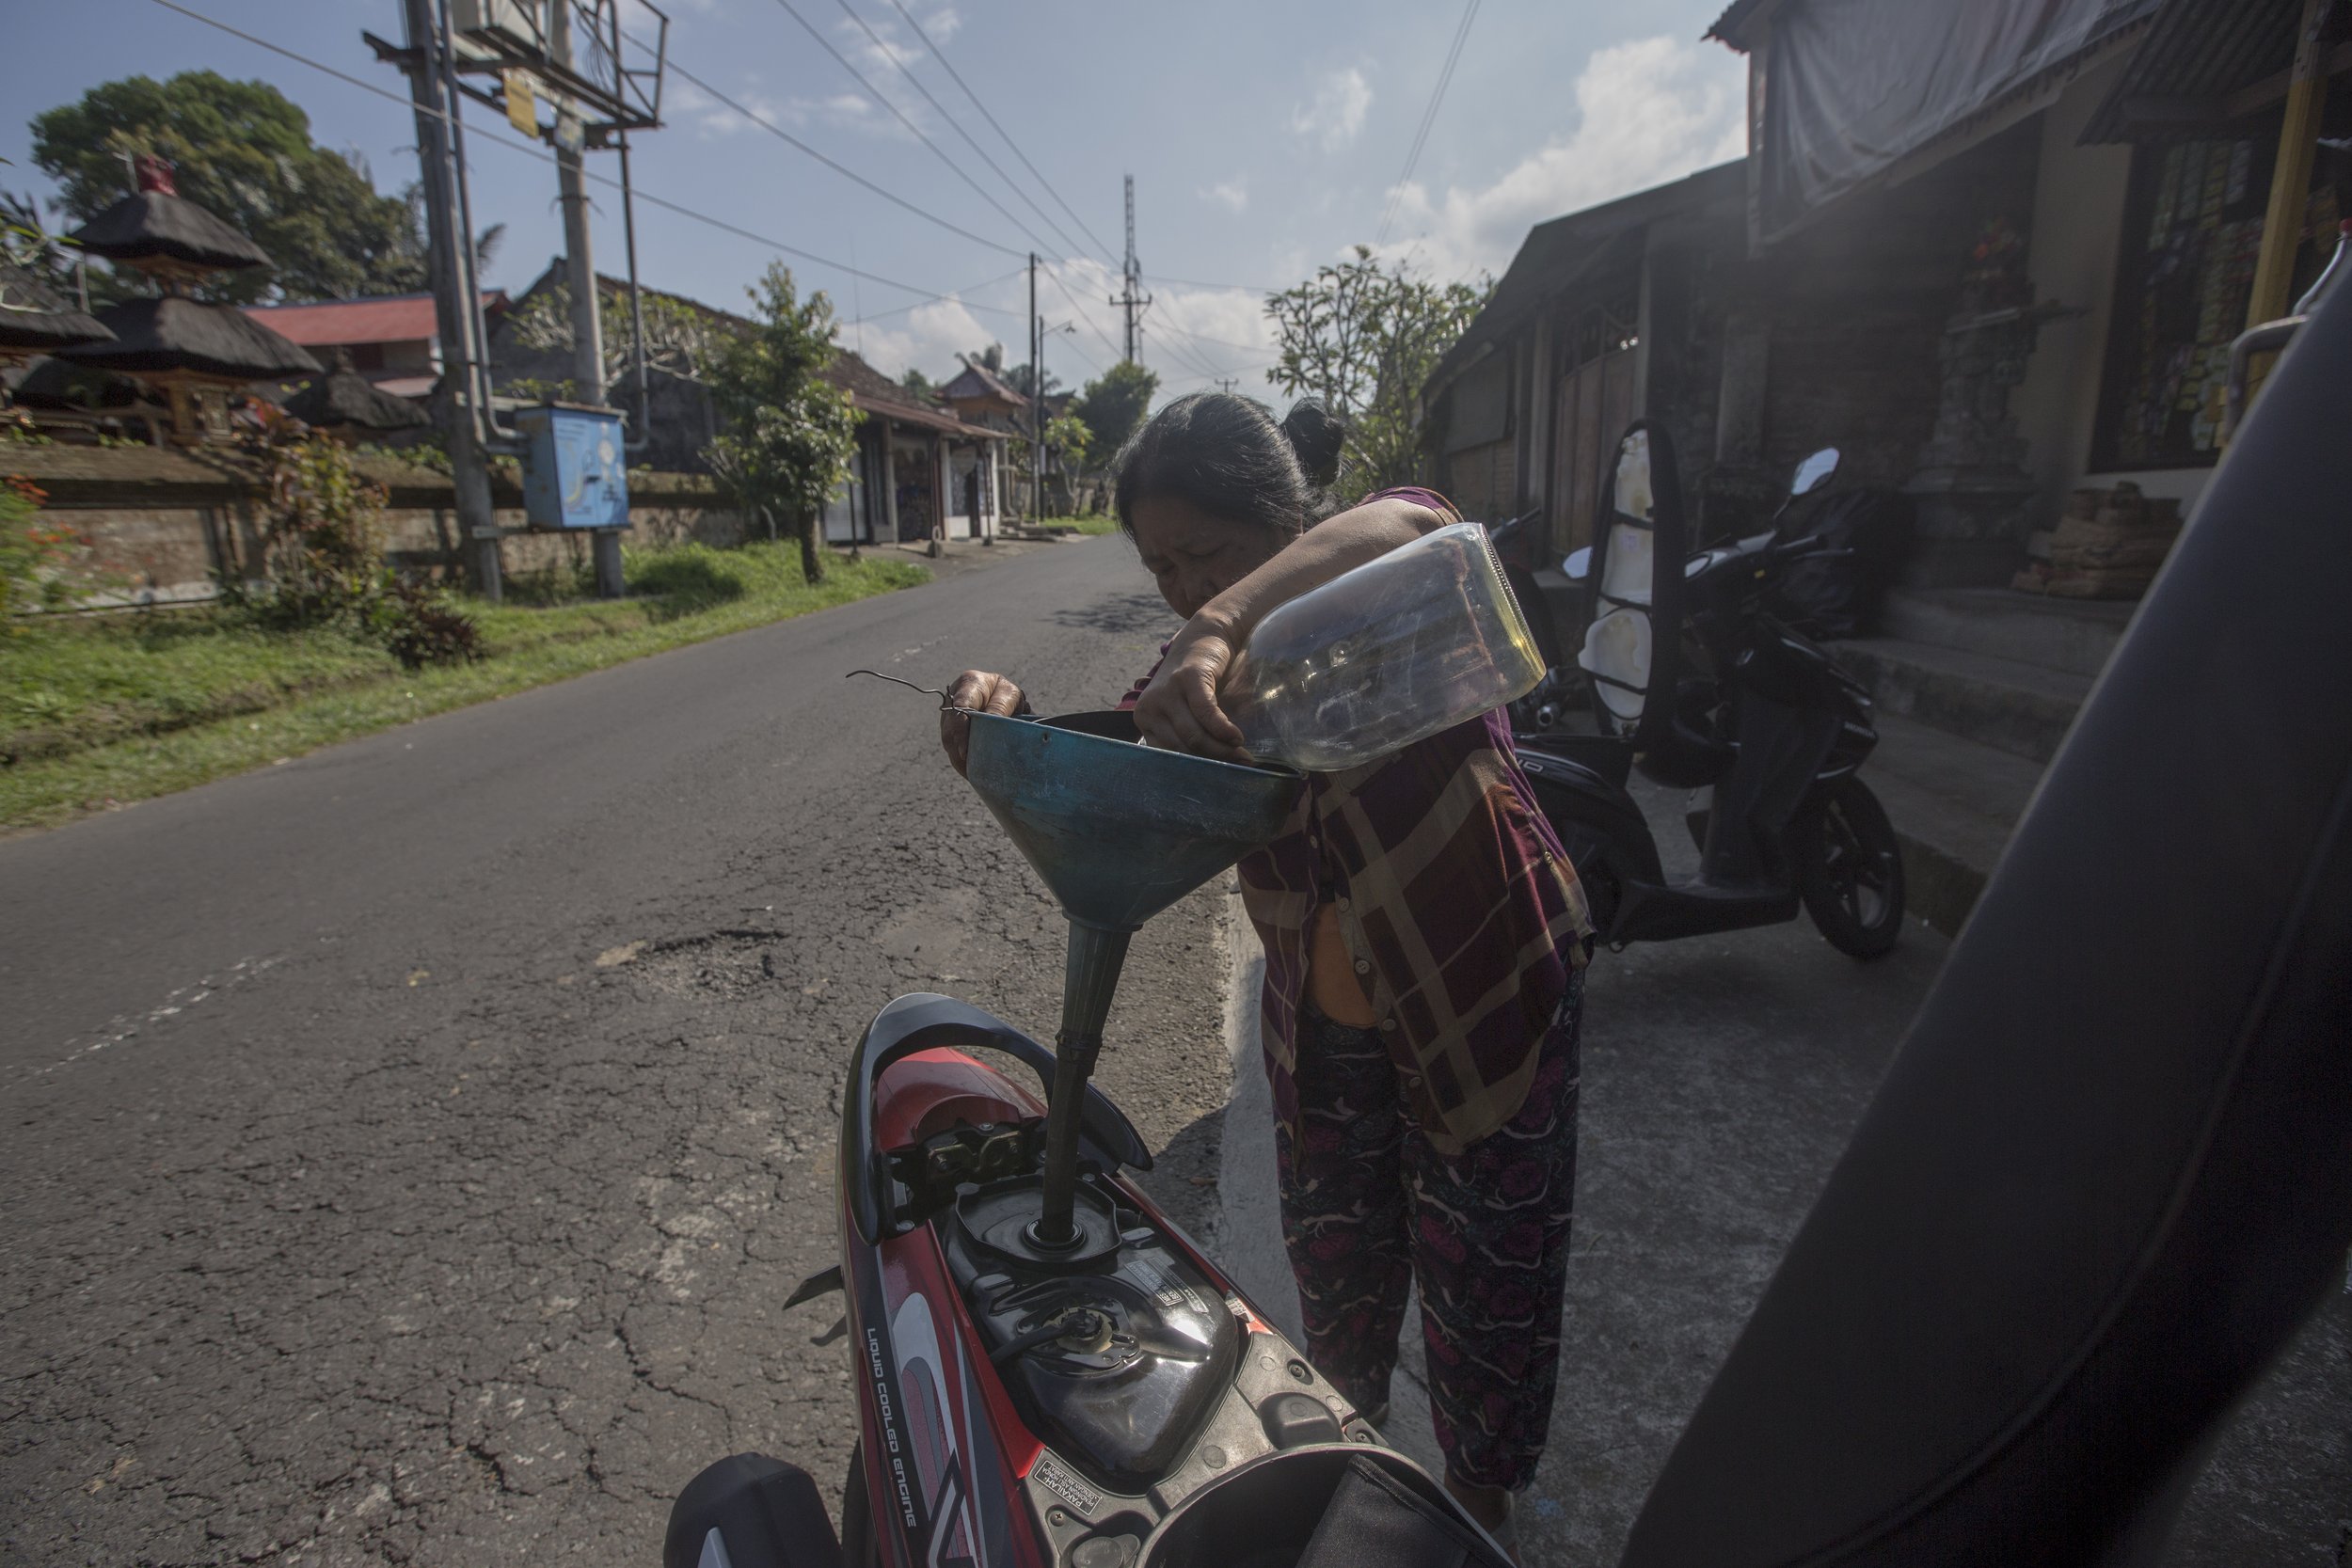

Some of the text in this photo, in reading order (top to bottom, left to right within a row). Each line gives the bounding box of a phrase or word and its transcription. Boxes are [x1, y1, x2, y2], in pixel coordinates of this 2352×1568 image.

[867, 1327, 917, 1528] LIQUID COOLED ENGINE
[1057, 1478, 1070, 1489] ASLI
